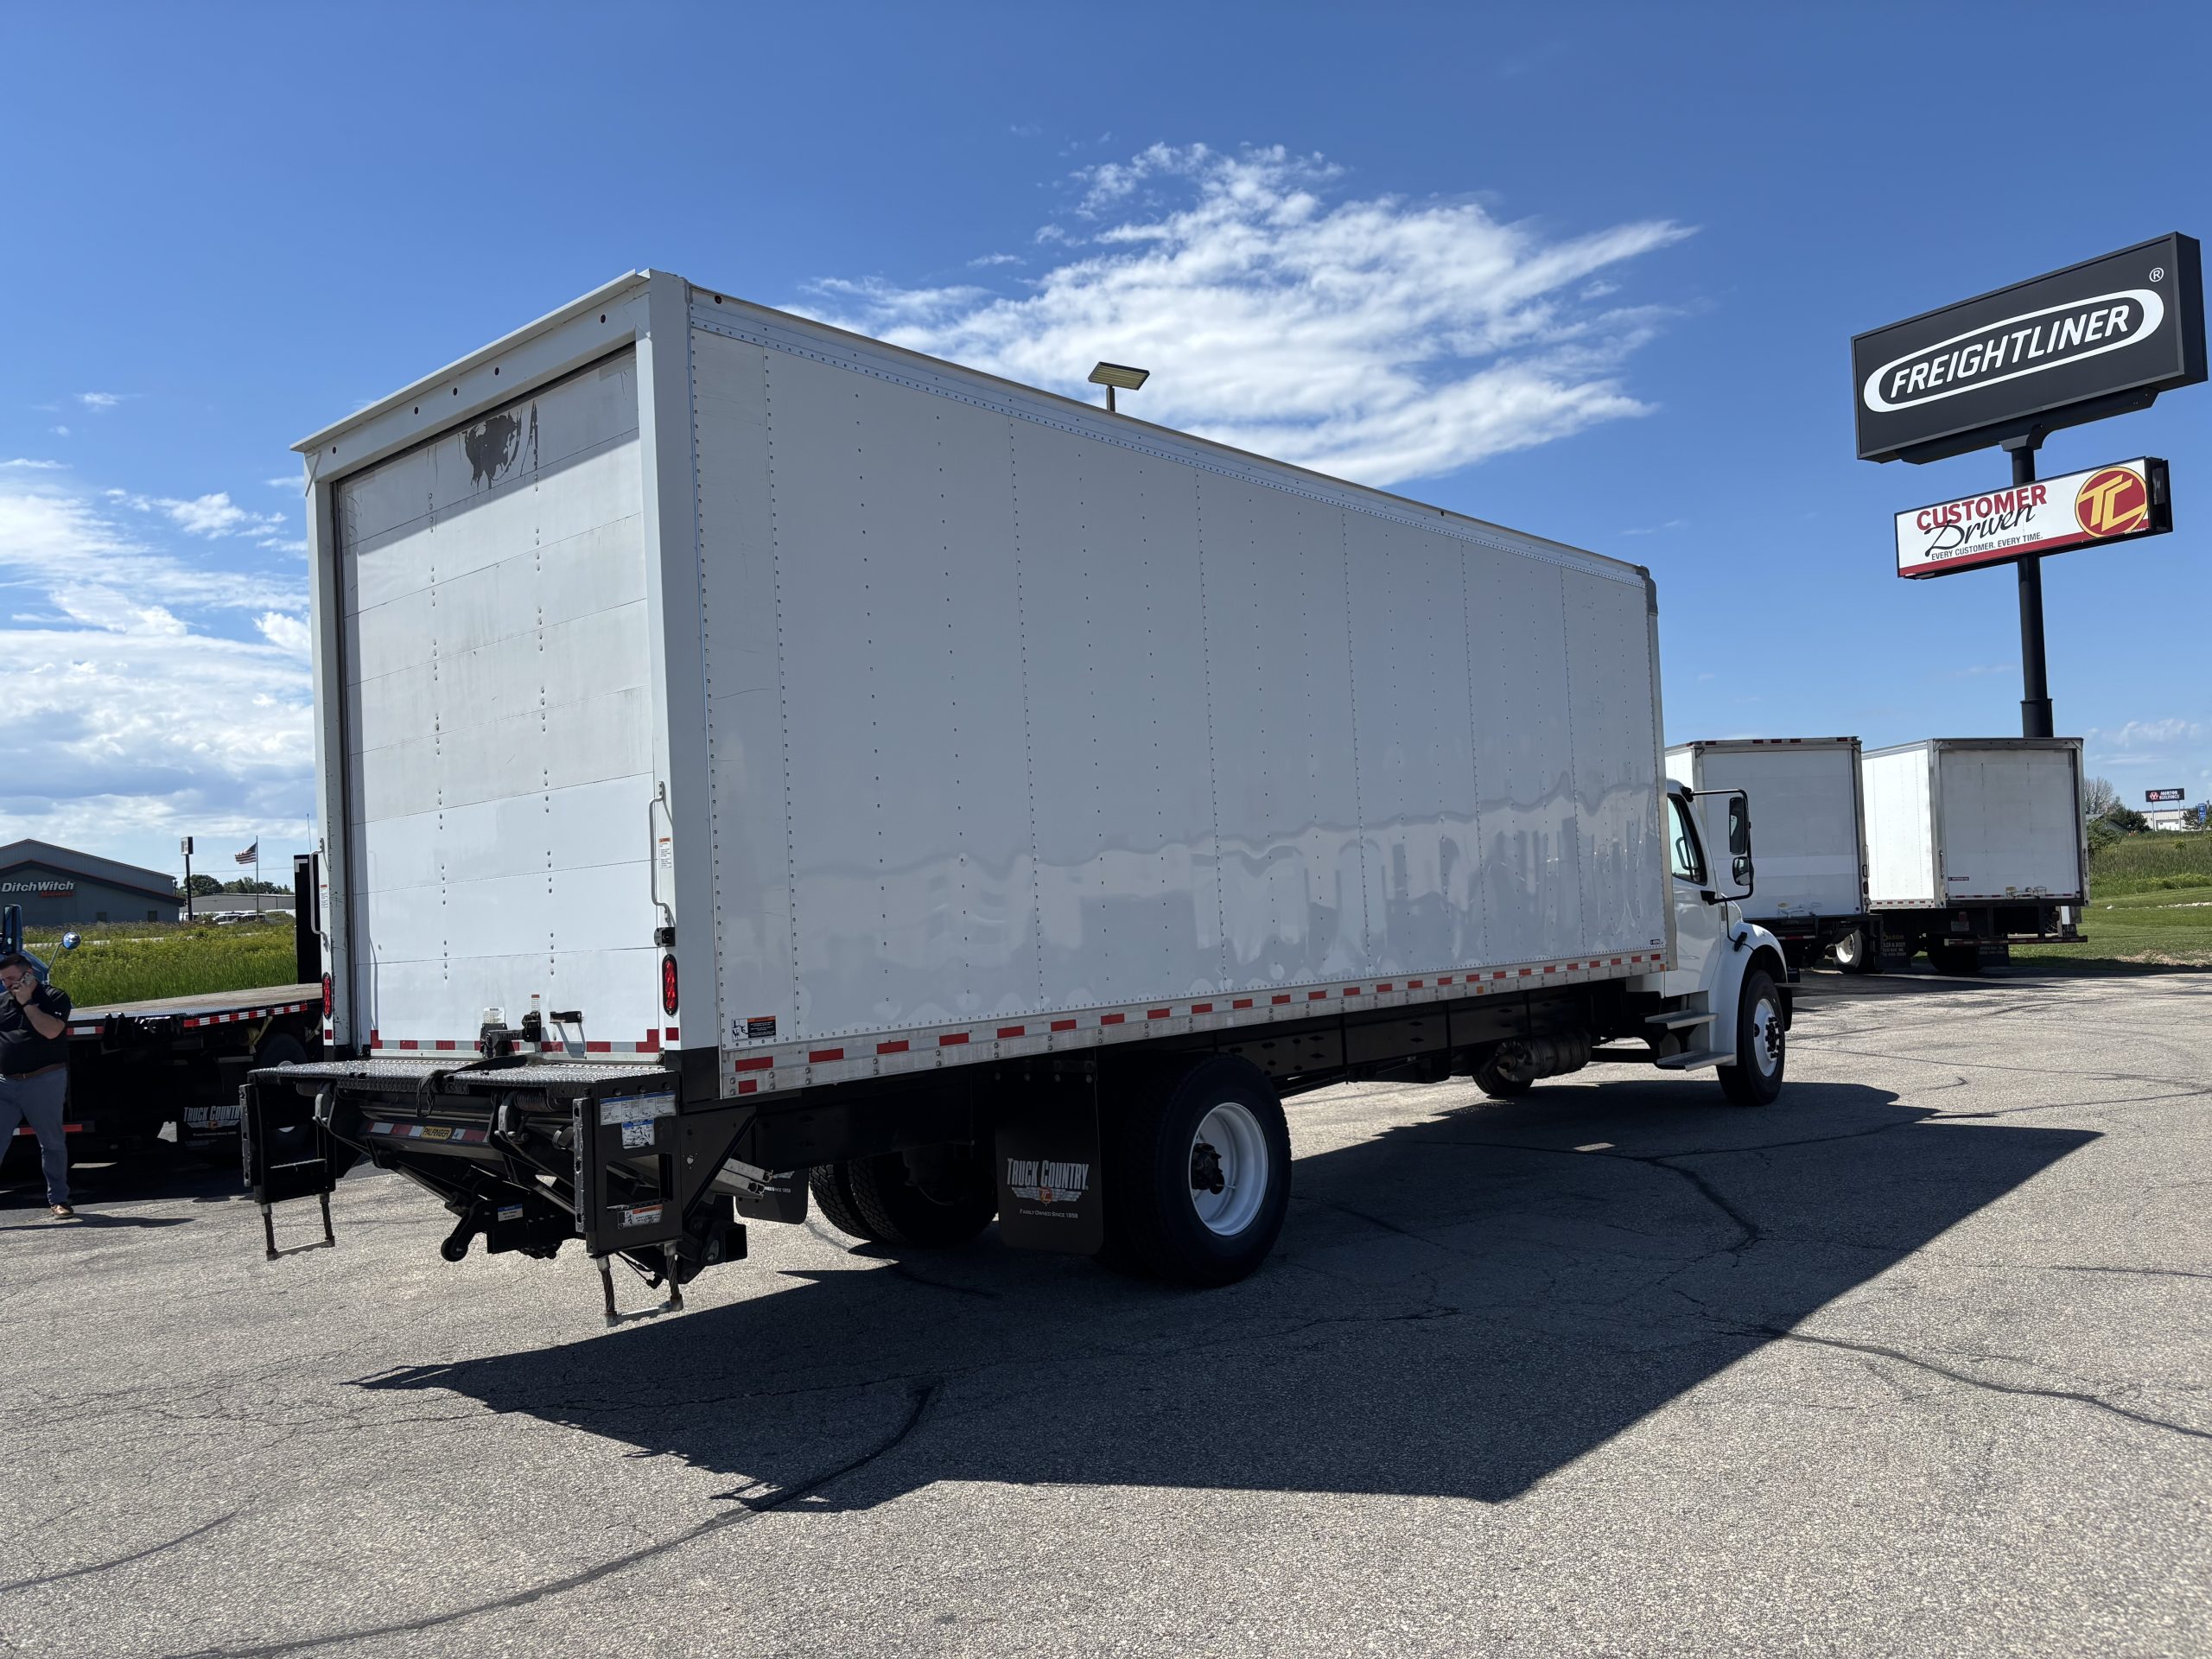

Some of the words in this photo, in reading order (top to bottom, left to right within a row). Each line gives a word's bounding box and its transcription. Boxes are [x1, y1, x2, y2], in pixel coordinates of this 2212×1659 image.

[1890, 304, 2130, 398] FREIGHTLINER
[1916, 484, 2047, 531] CUSTOMER
[1923, 504, 2036, 557] Driven
[1931, 550, 1954, 561] EVERY
[1955, 542, 1996, 556] CUSTOMER.
[1997, 536, 2021, 548] EVERY
[2022, 531, 2044, 543] TIME.
[184, 1106, 209, 1122] TRUCK
[209, 1105, 241, 1121] COUNTR
[1007, 1158, 1039, 1186] TRUCK
[1040, 1160, 1090, 1191] COUNTRY
